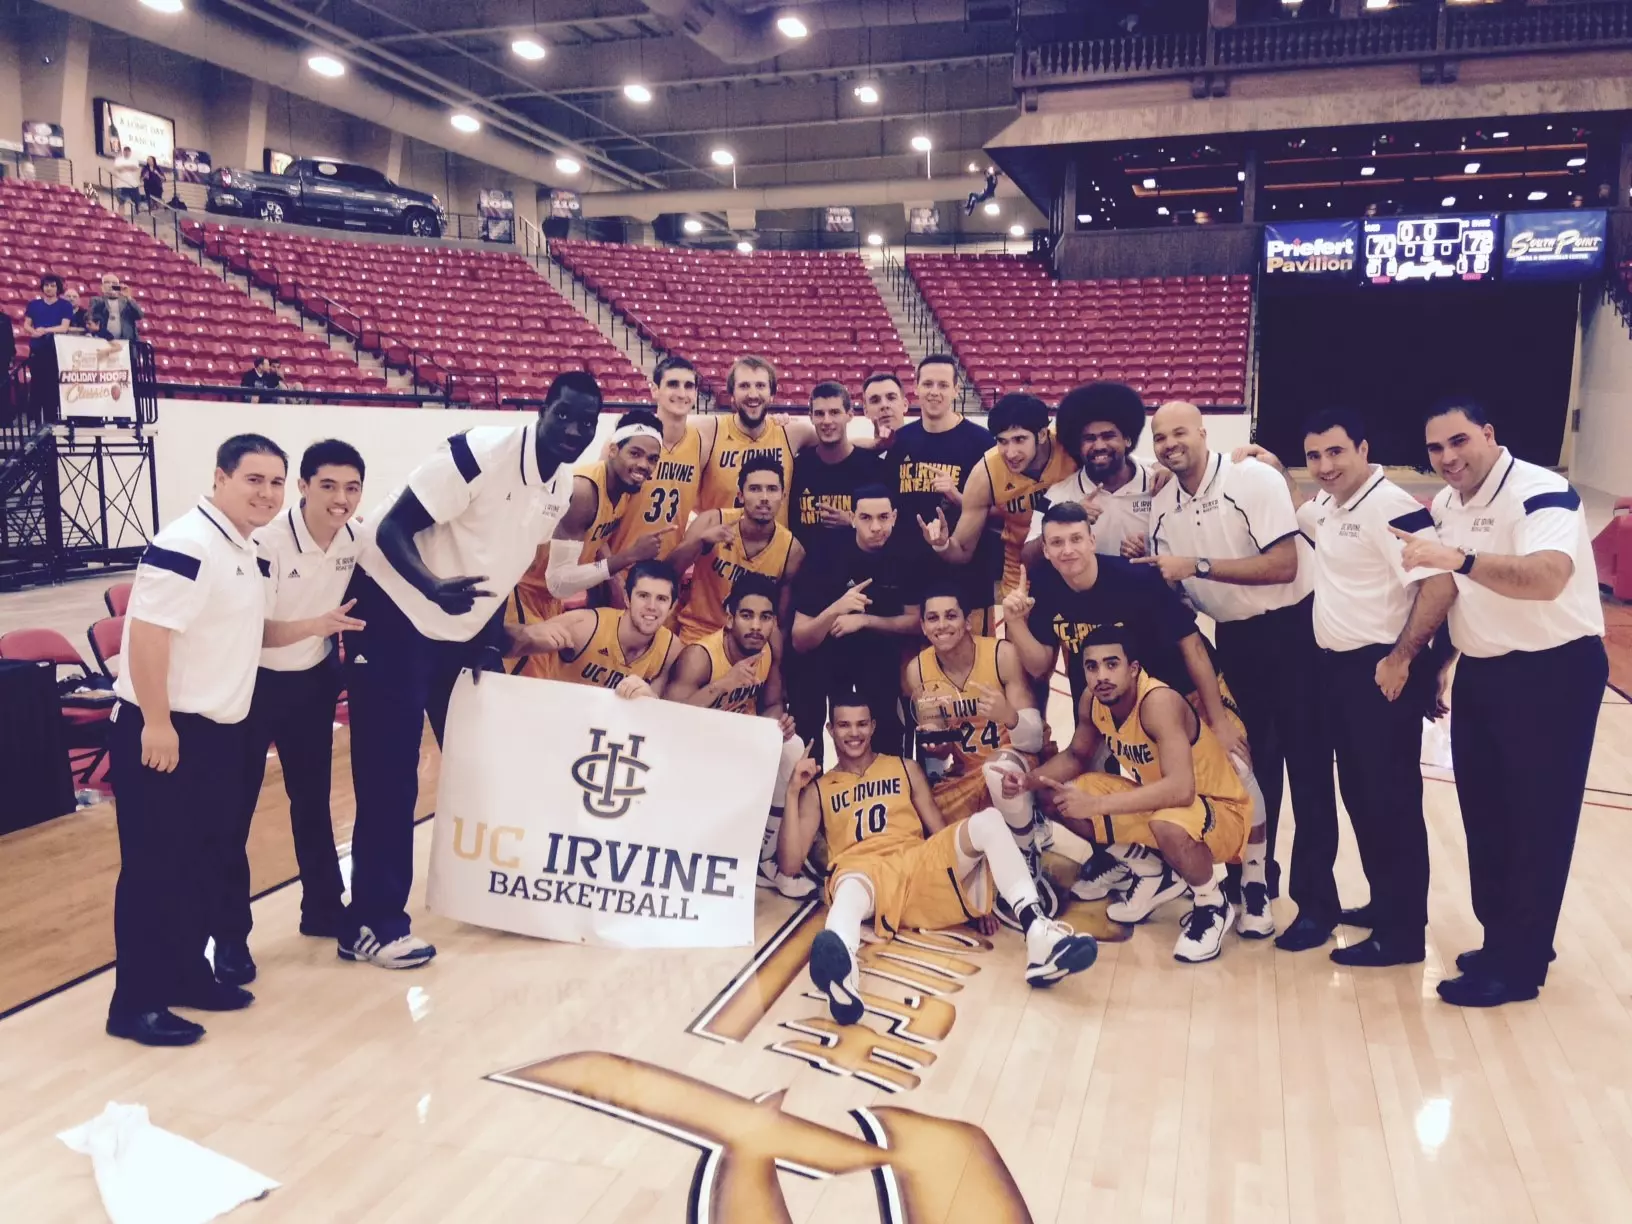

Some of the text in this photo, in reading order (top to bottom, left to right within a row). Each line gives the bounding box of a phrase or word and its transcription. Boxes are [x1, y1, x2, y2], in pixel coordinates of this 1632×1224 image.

[1267, 238, 1354, 258] Priefert
[1266, 255, 1353, 274] Pavilion
[62, 371, 127, 383] HOLIDAY HOOPS
[719, 450, 740, 468] UC
[656, 462, 695, 482] IRVINE
[643, 487, 680, 523] 33
[1006, 494, 1027, 514] UC
[713, 557, 731, 578] UC
[581, 662, 608, 683] UC
[959, 720, 1001, 753] 24
[831, 777, 901, 813] UC IRVINE
[855, 803, 887, 842] 10
[452, 816, 739, 898] UC IRVINE
[488, 870, 700, 921] BASKETBALL
